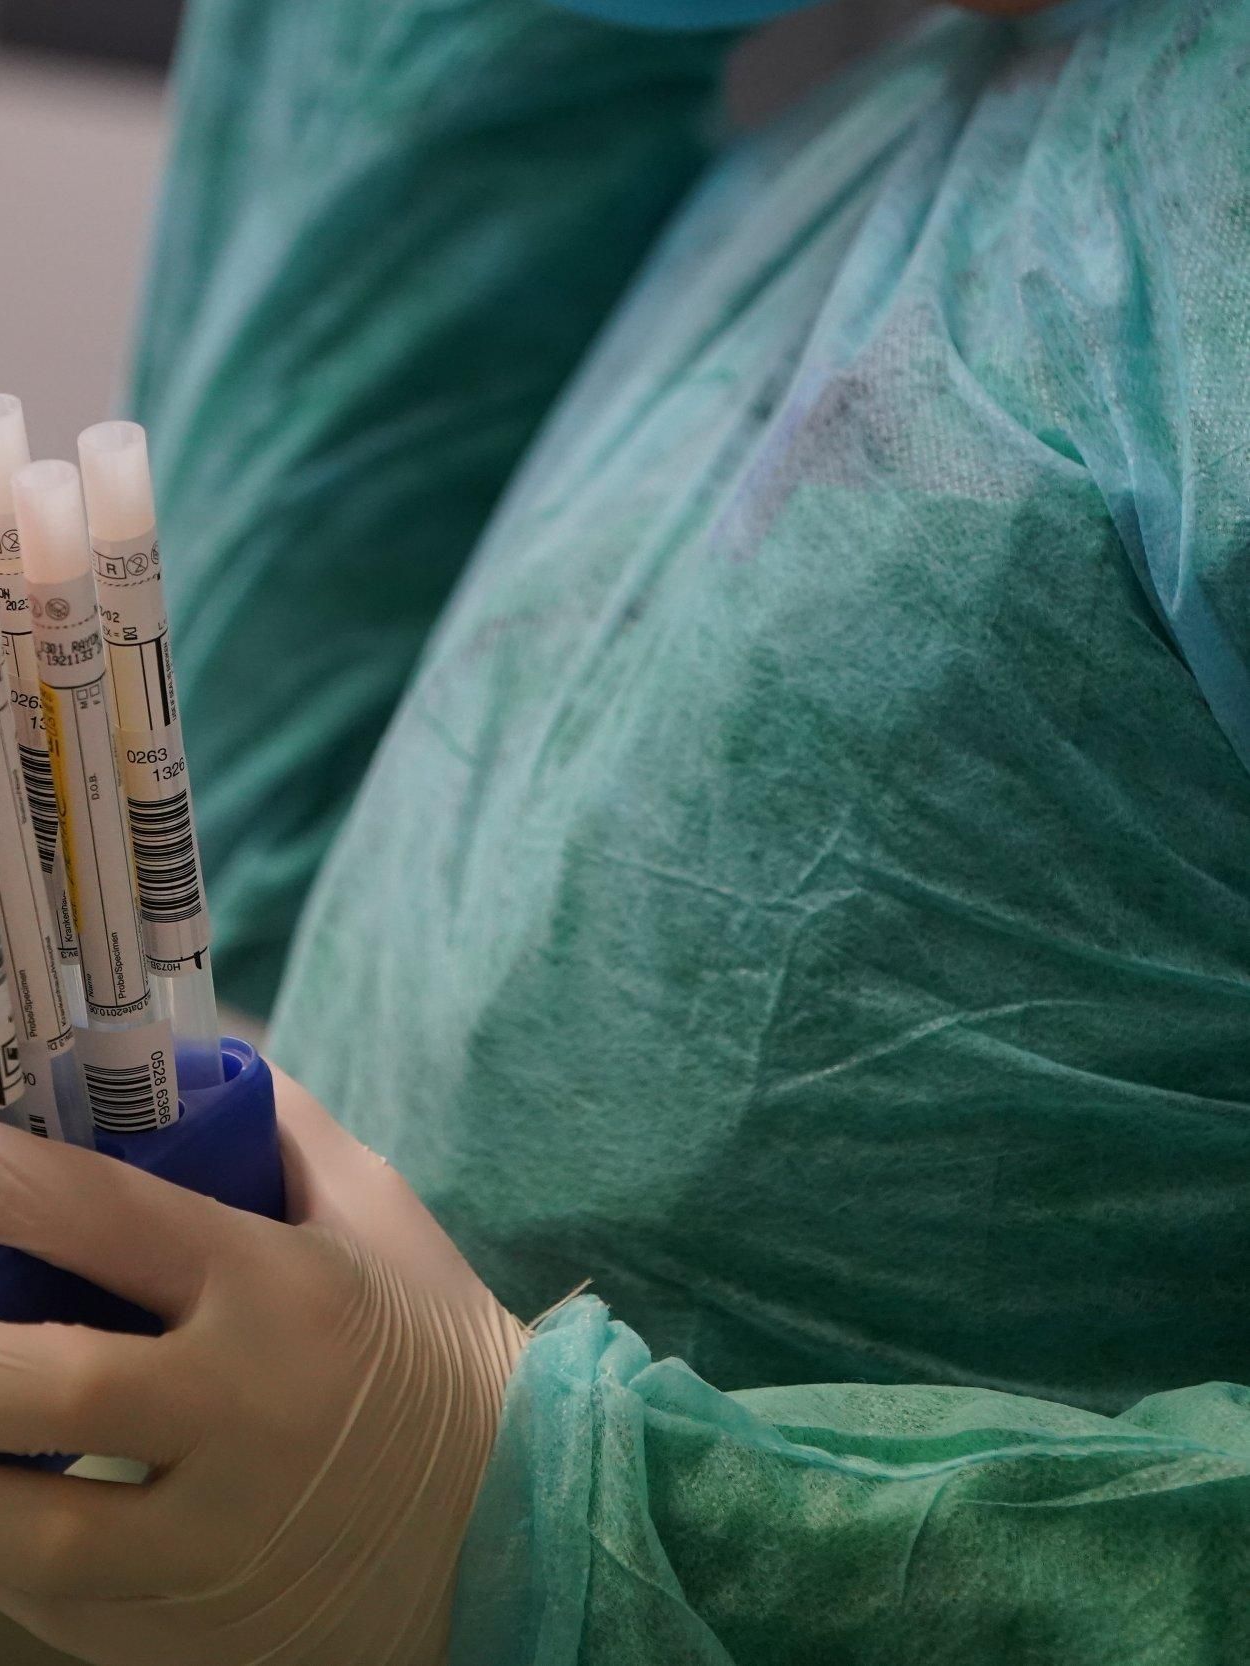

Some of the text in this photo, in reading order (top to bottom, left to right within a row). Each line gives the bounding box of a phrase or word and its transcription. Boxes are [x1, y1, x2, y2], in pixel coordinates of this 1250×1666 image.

[106, 562, 117, 575] R
[164, 642, 172, 672] BROKEN
[126, 748, 168, 764] 0263
[152, 757, 185, 782] 1326
[88, 773, 100, 800] D.O.B.
[112, 932, 126, 1000] Probe/Specimen
[19, 969, 38, 1038] Probe/Specimen
[150, 1050, 171, 1126] 0528 6366
